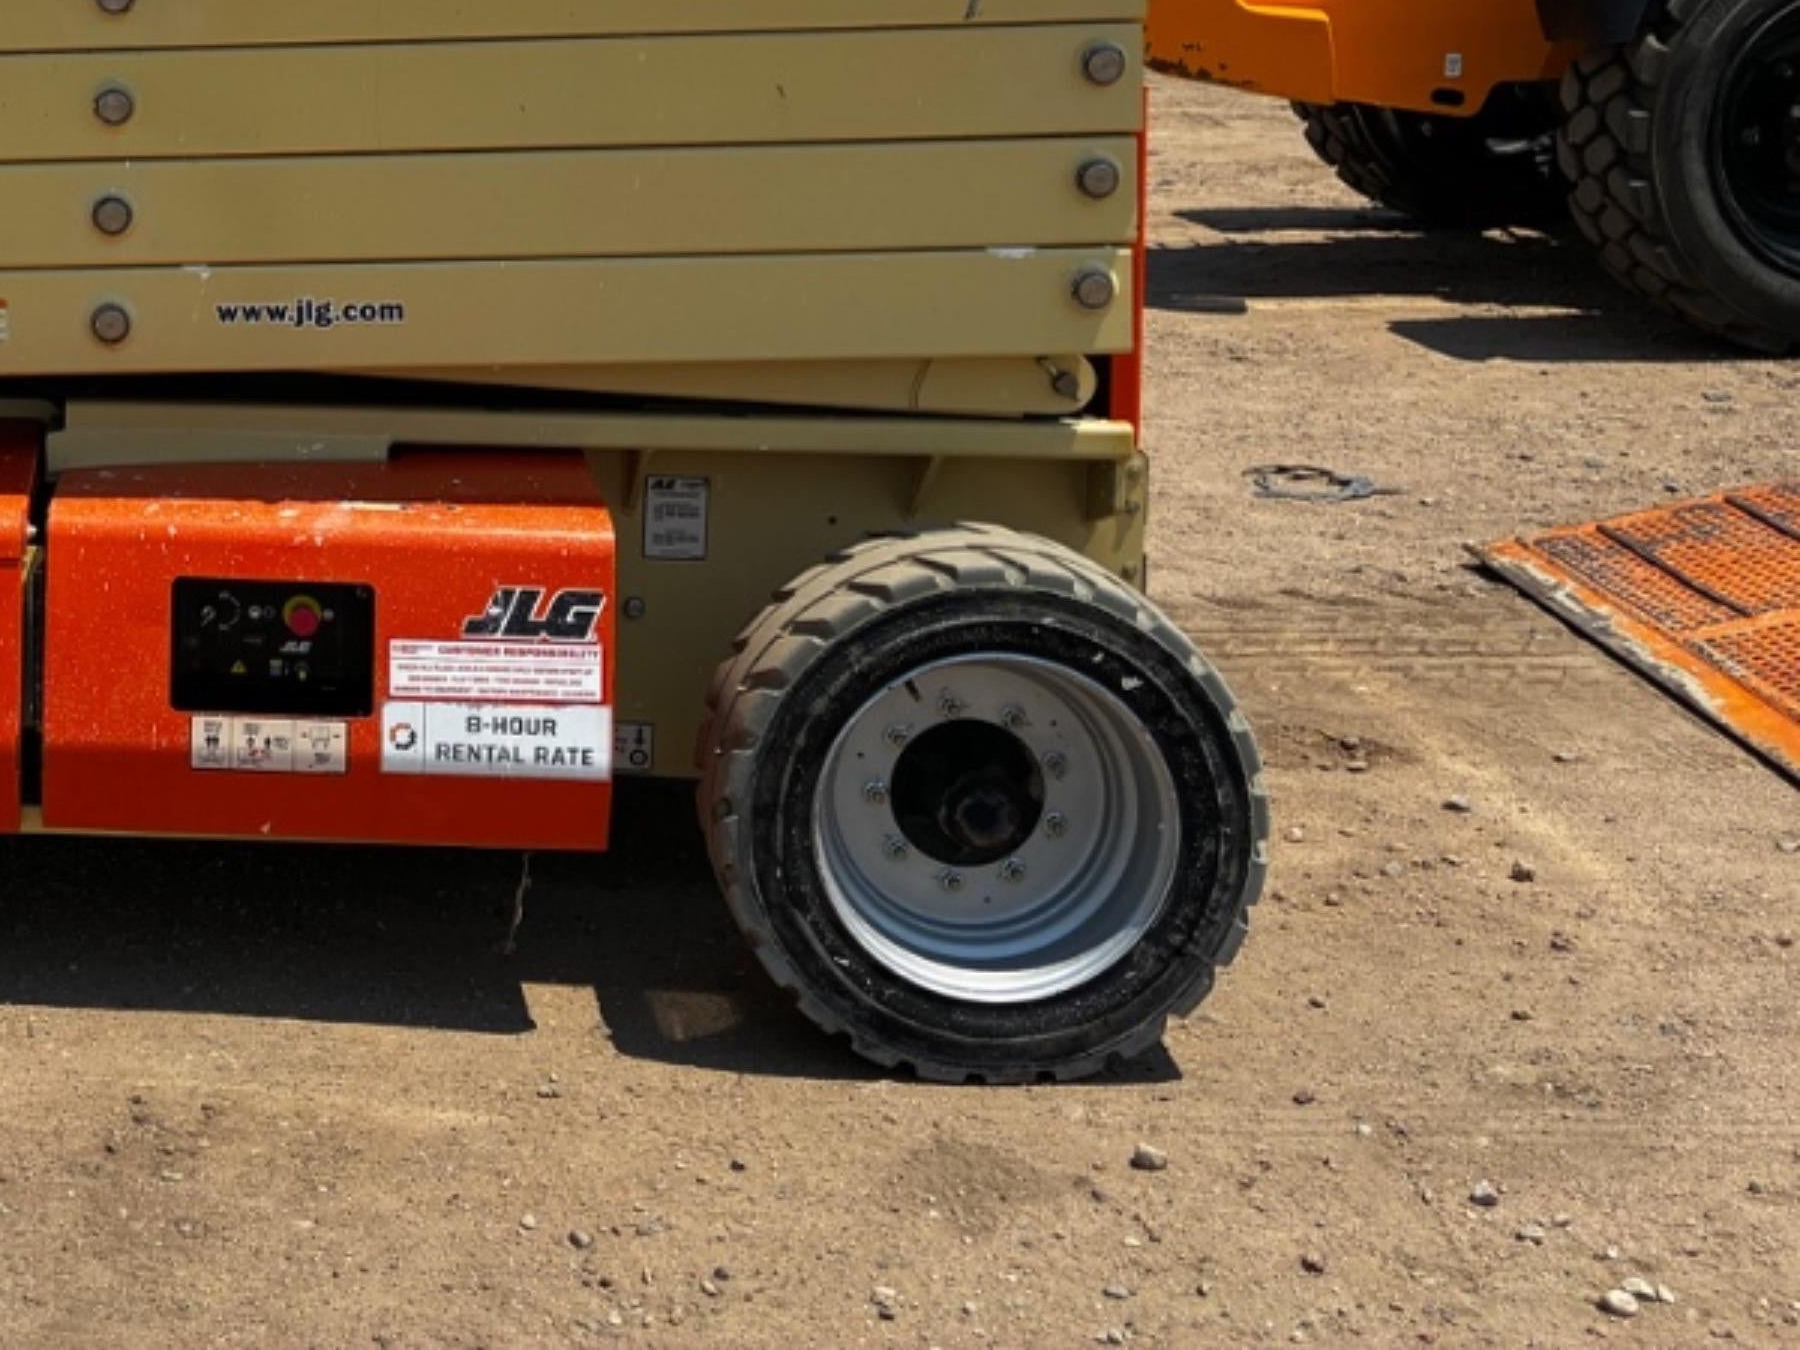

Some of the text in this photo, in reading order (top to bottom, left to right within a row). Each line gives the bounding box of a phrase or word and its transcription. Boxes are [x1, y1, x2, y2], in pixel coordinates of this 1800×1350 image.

[216, 298, 405, 327] www.jlg.com
[462, 585, 607, 641] JLG
[466, 716, 558, 736] 8-HOUR
[434, 743, 526, 763] RENTAL
[533, 746, 595, 767] RATE
